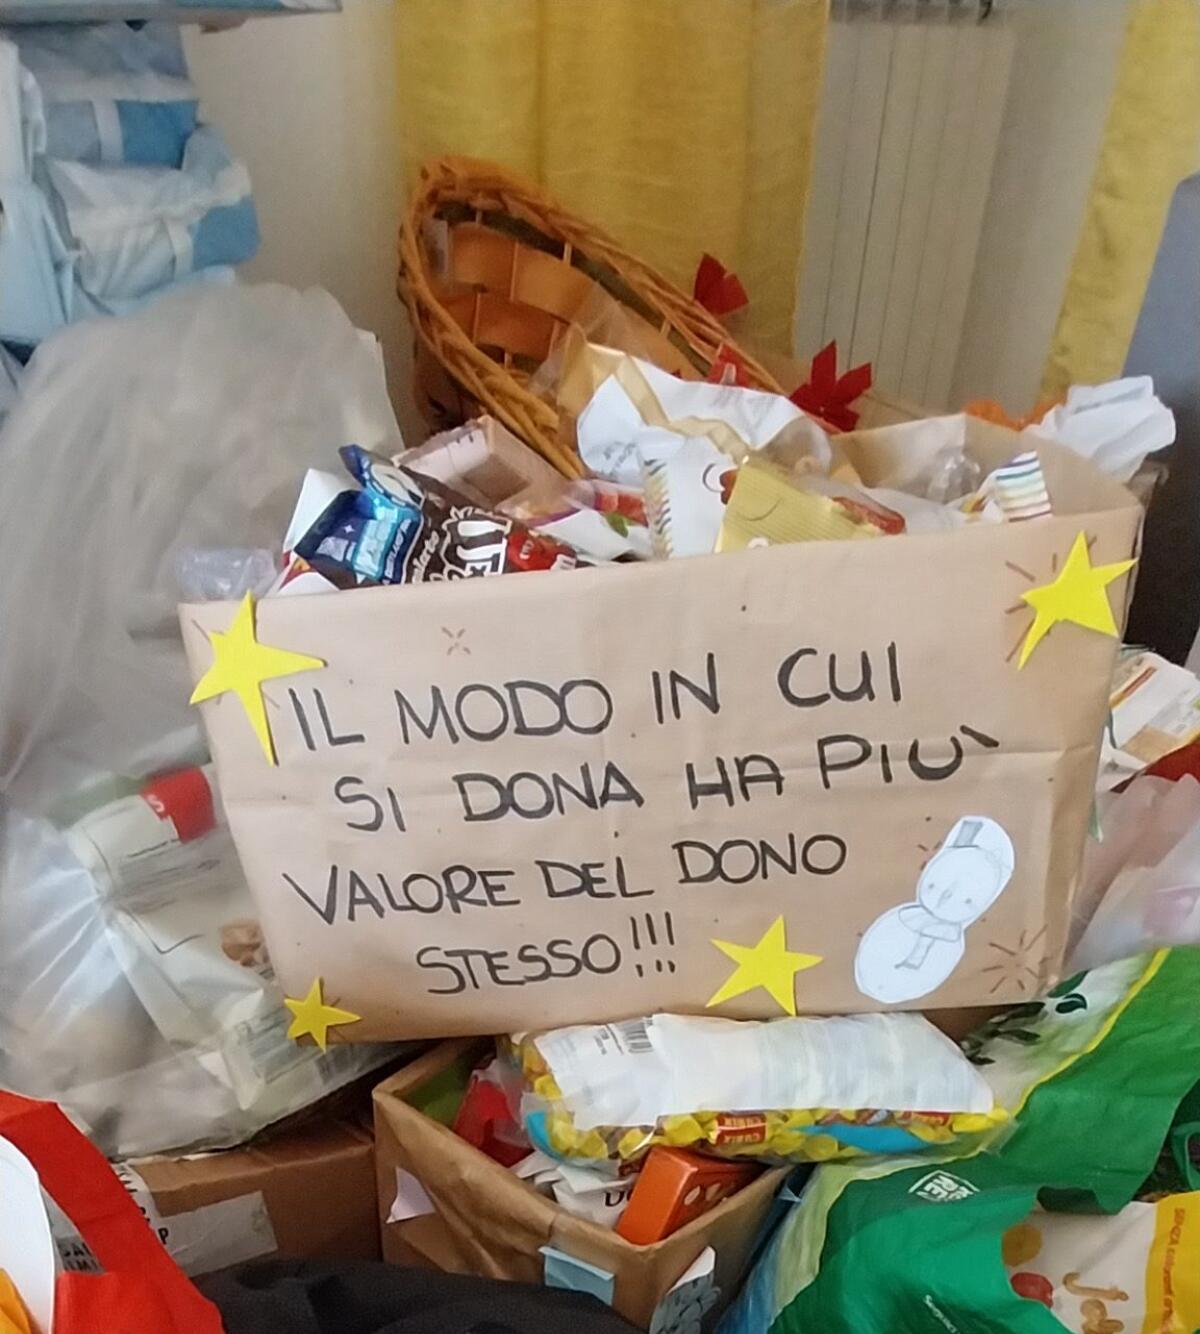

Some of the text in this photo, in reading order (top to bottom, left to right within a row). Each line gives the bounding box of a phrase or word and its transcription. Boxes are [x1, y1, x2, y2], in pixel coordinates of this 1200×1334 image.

[288, 640, 902, 752] IL MODO IN CUI
[334, 774, 407, 834] SI
[458, 761, 645, 824] DONA
[686, 750, 784, 811] HA
[282, 832, 848, 927] VALORE DEL DONO
[414, 911, 679, 994] STESSO!!!
